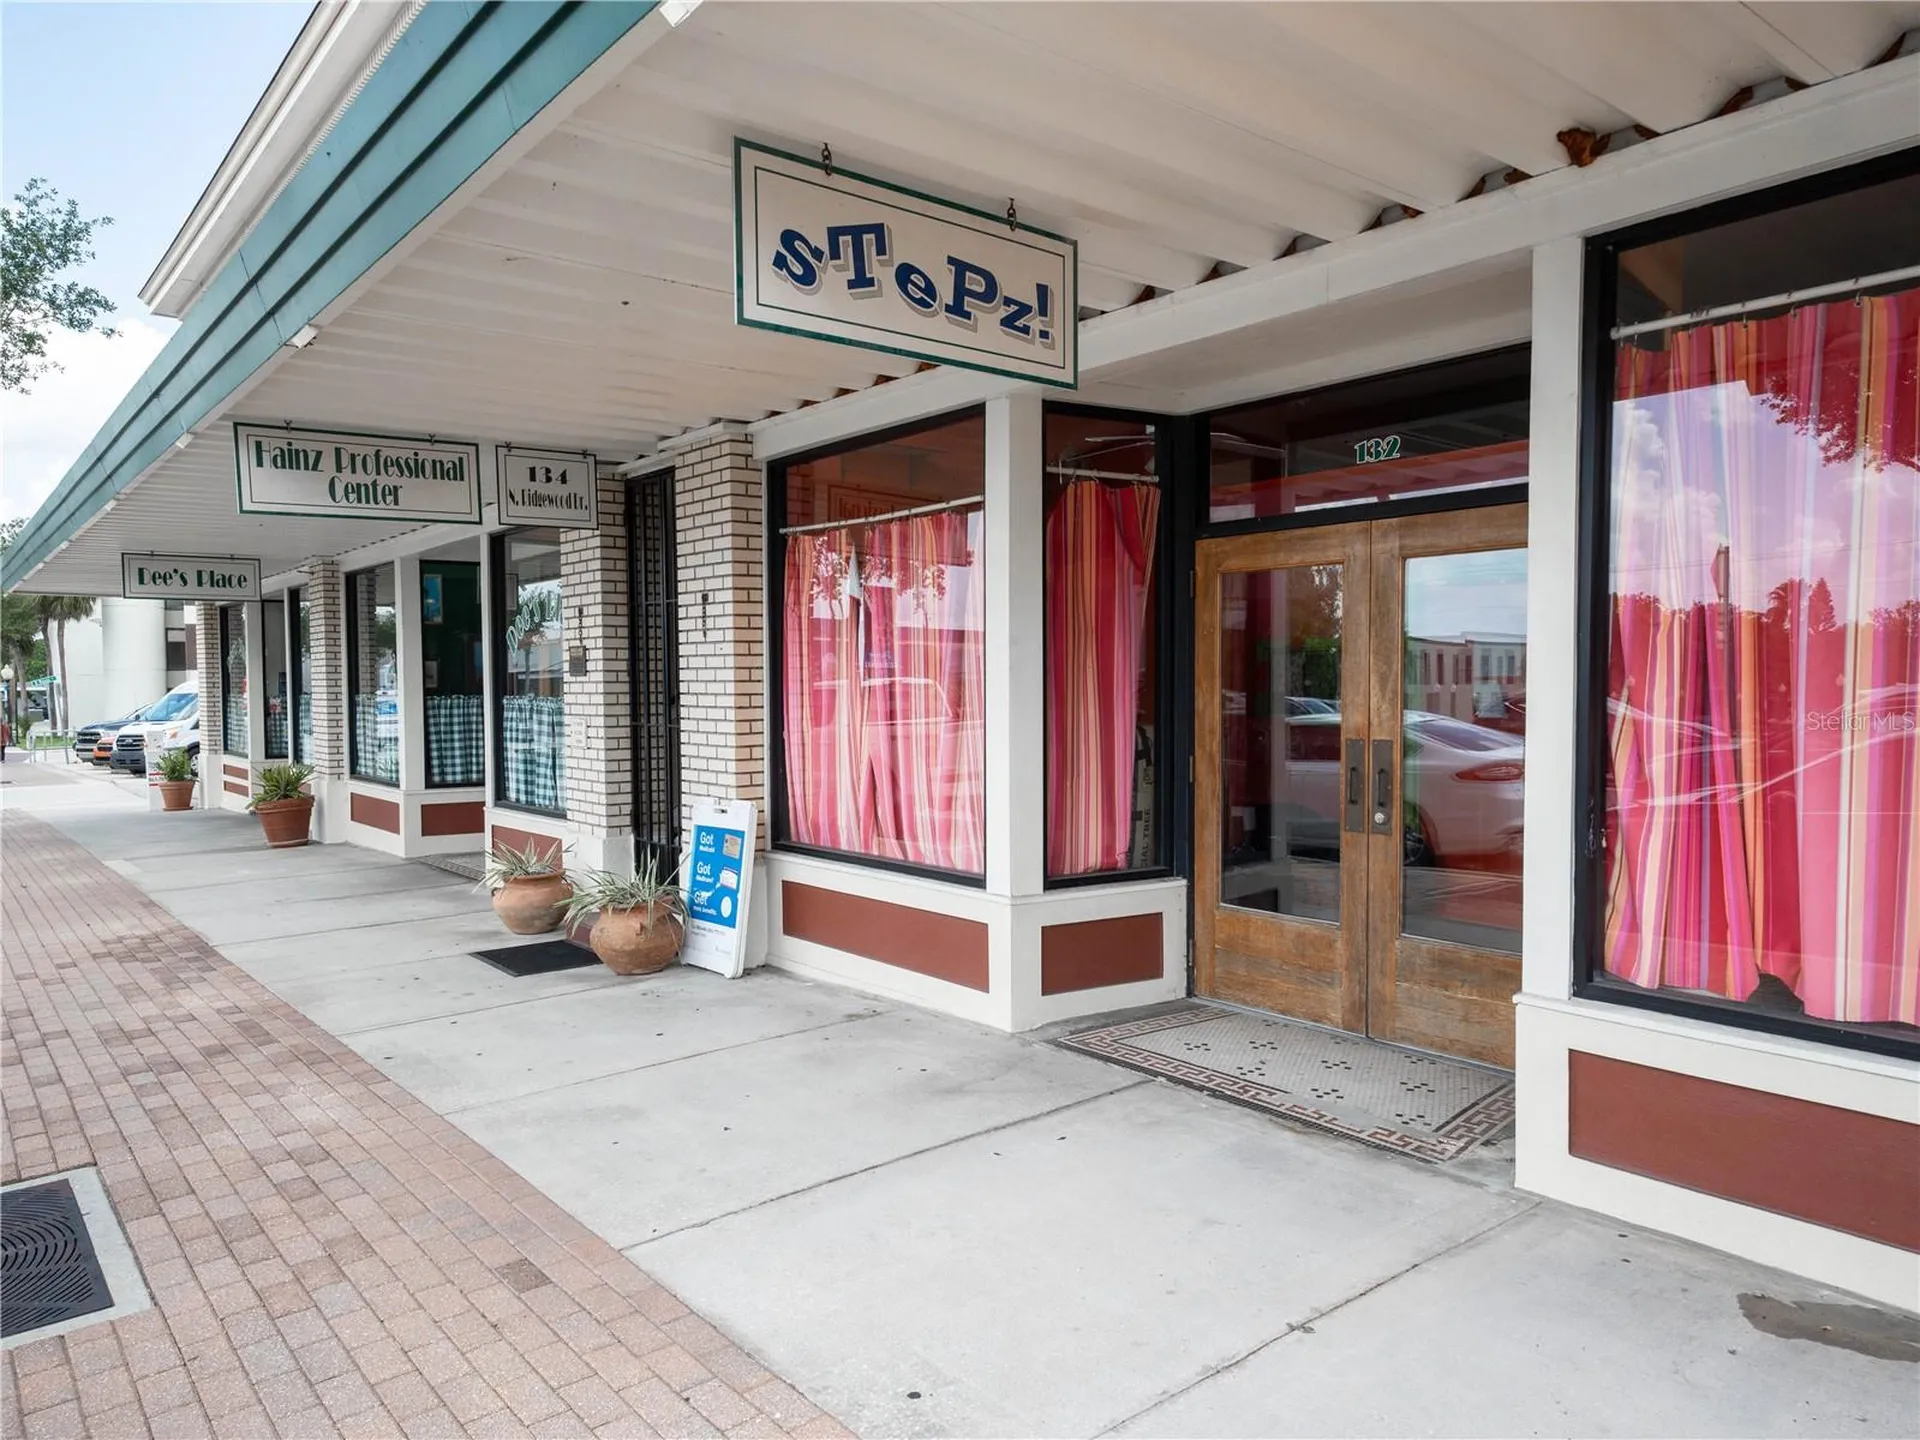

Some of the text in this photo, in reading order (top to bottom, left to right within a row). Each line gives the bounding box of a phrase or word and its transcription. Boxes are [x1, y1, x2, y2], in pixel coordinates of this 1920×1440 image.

[1354, 435, 1401, 464] 132
[255, 440, 465, 482] Hainz Professional
[527, 465, 570, 485] 134
[328, 475, 403, 506] Center
[137, 567, 248, 589] Dee's Place
[700, 831, 714, 846] Got
[697, 861, 711, 876] Got
